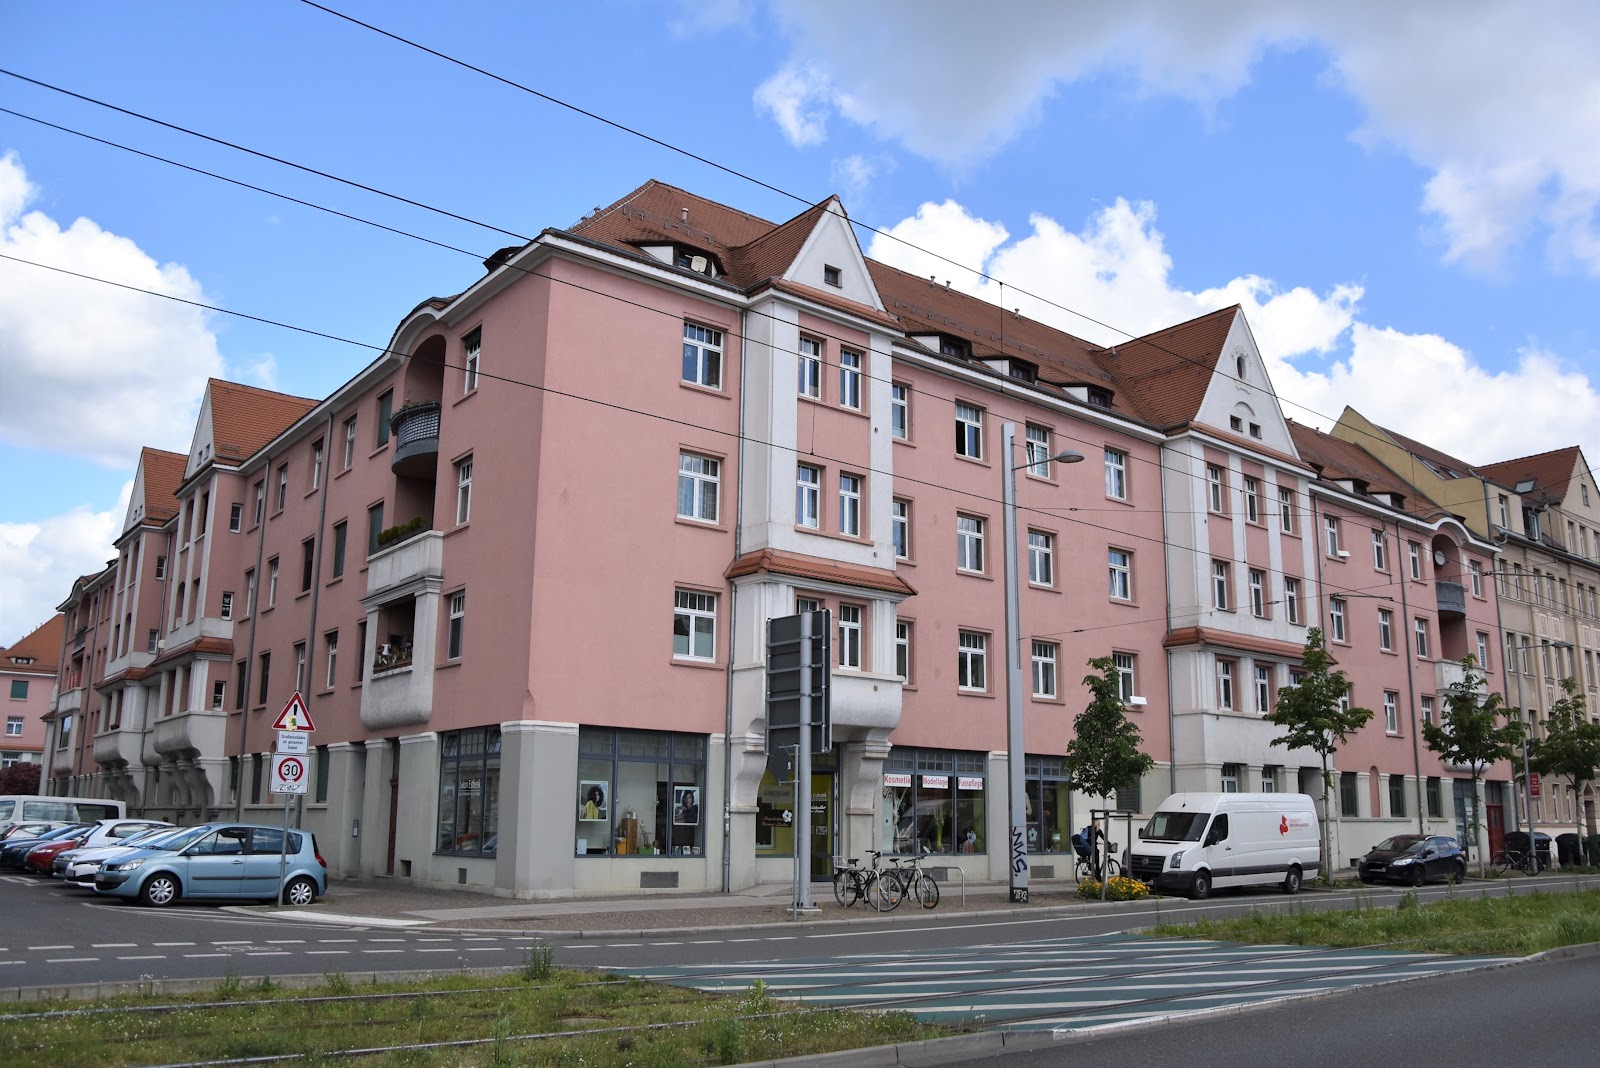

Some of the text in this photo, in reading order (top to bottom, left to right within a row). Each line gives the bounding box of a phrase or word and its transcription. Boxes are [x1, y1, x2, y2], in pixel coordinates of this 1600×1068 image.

[283, 764, 298, 777] 30
[884, 775, 911, 784] Kosmetik
[922, 777, 948, 787] Modellage
